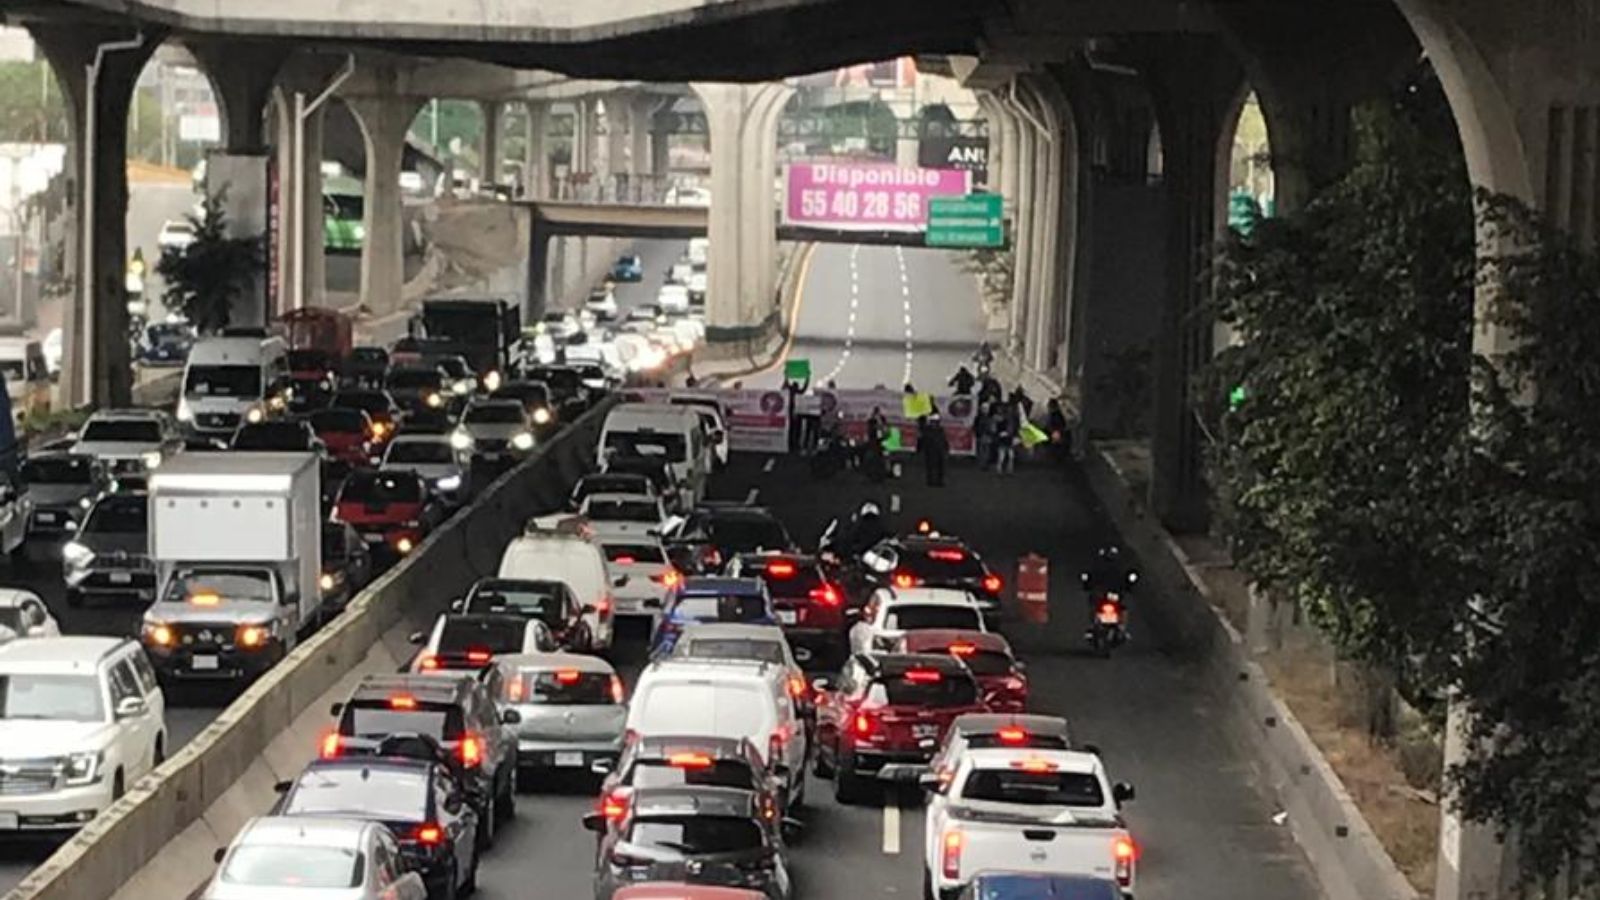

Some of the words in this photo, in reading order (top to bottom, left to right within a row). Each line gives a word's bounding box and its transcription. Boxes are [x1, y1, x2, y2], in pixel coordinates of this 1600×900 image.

[811, 164, 941, 188] Disponible
[801, 189, 827, 217] 55
[831, 190, 858, 218] 40
